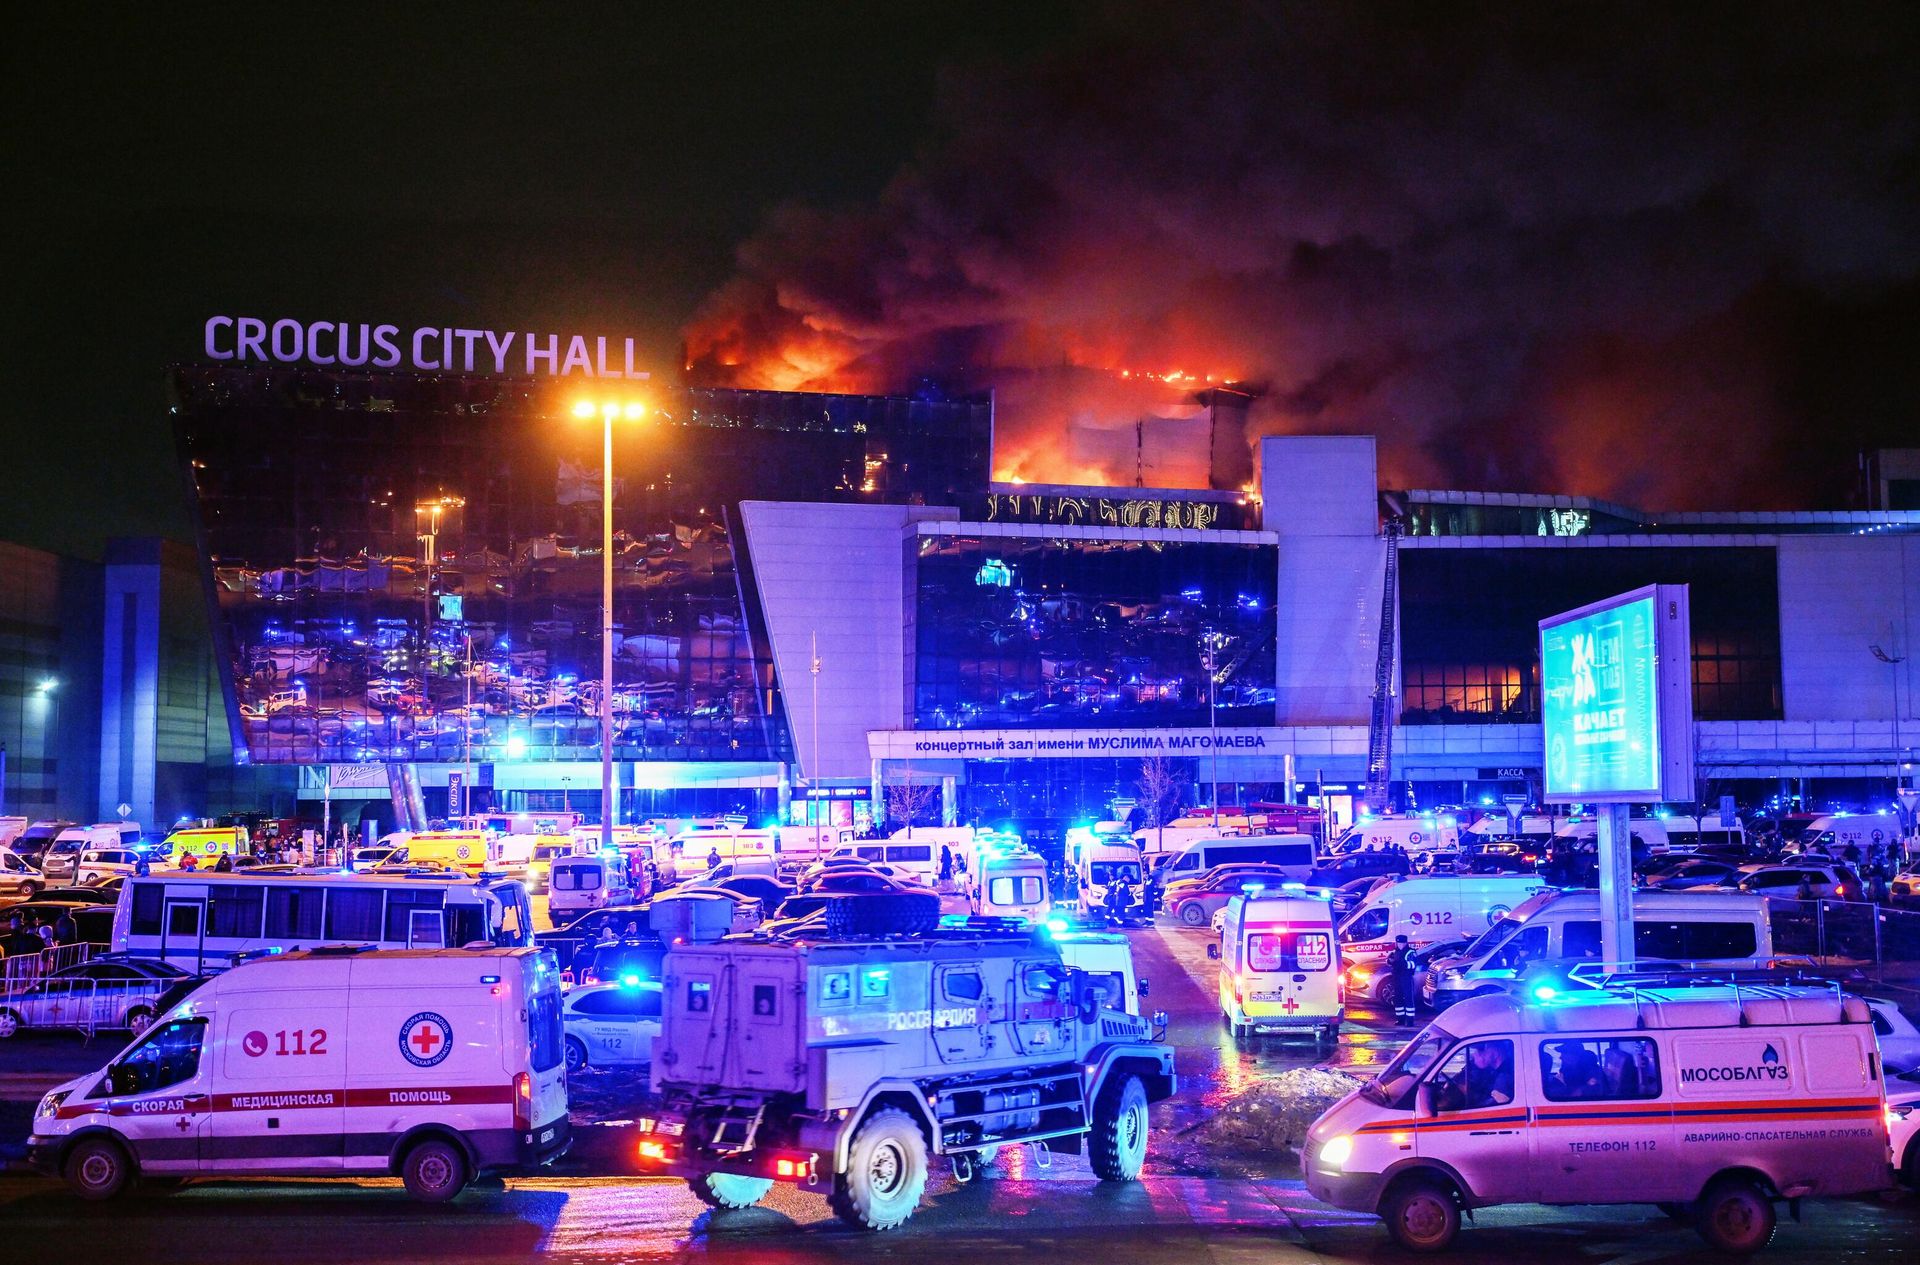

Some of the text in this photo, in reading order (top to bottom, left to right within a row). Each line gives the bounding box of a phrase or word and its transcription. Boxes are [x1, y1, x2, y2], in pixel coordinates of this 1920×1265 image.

[205, 315, 650, 380] CROCUS CITY HALL
[1574, 708, 1626, 731] КАЧАЕТ
[915, 735, 1266, 753] концертный зал имени МУСЛИМА МАГОМАЕВА
[450, 776, 459, 807] ЭКСПО
[1425, 911, 1453, 925] 112
[1297, 940, 1326, 956] 112
[402, 1014, 450, 1035] СКОРАЯ ПОМОЩЬ
[887, 1008, 977, 1031] РОСГВАРДИЯ
[275, 1028, 327, 1056] 112
[401, 1040, 432, 1065] МОСКОВСКАЯ
[602, 1038, 622, 1048] 112
[1681, 1065, 1789, 1082] МОСОБЛГАЗ
[132, 1090, 452, 1113] СКОРАЯ МЕДИЦИНСКАЯ ПОМОЩЬ
[1569, 1140, 1657, 1152] ТЕЛЕФОН 112
[1684, 1128, 1874, 1143] АВАРИЙНО-СПАСАТЕЛЬНАЯ СЛУЖБА
